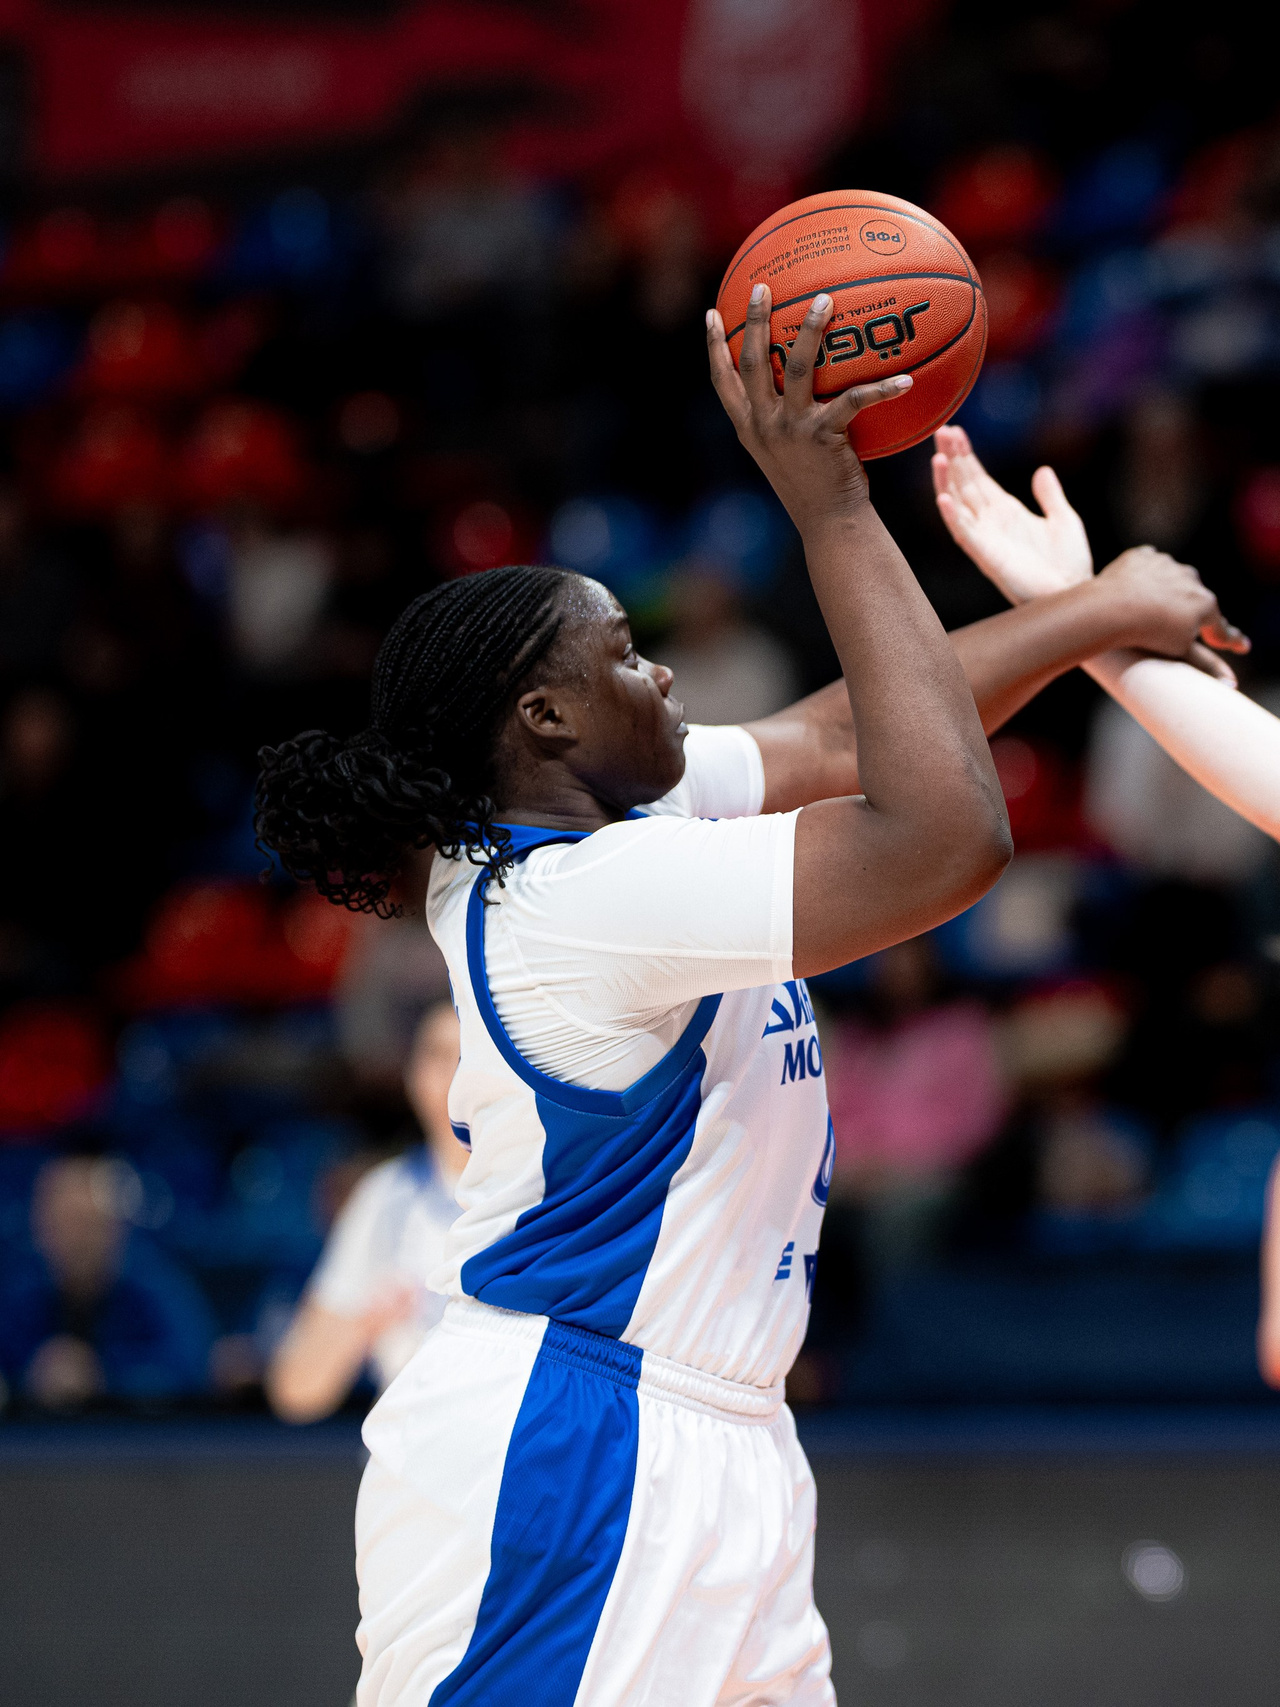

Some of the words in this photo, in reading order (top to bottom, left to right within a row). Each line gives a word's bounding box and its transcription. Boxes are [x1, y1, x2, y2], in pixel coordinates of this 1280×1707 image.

[795, 226, 848, 244] БАСКЕТБОЛА
[866, 231, 900, 243] РФБ
[793, 235, 850, 255] РОССИЙСКОЙ
[786, 244, 851, 269] ОФИЦИАЛЬНЫЙ
[768, 265, 784, 278] МЯЧ
[847, 297, 897, 317] OFFICIAL
